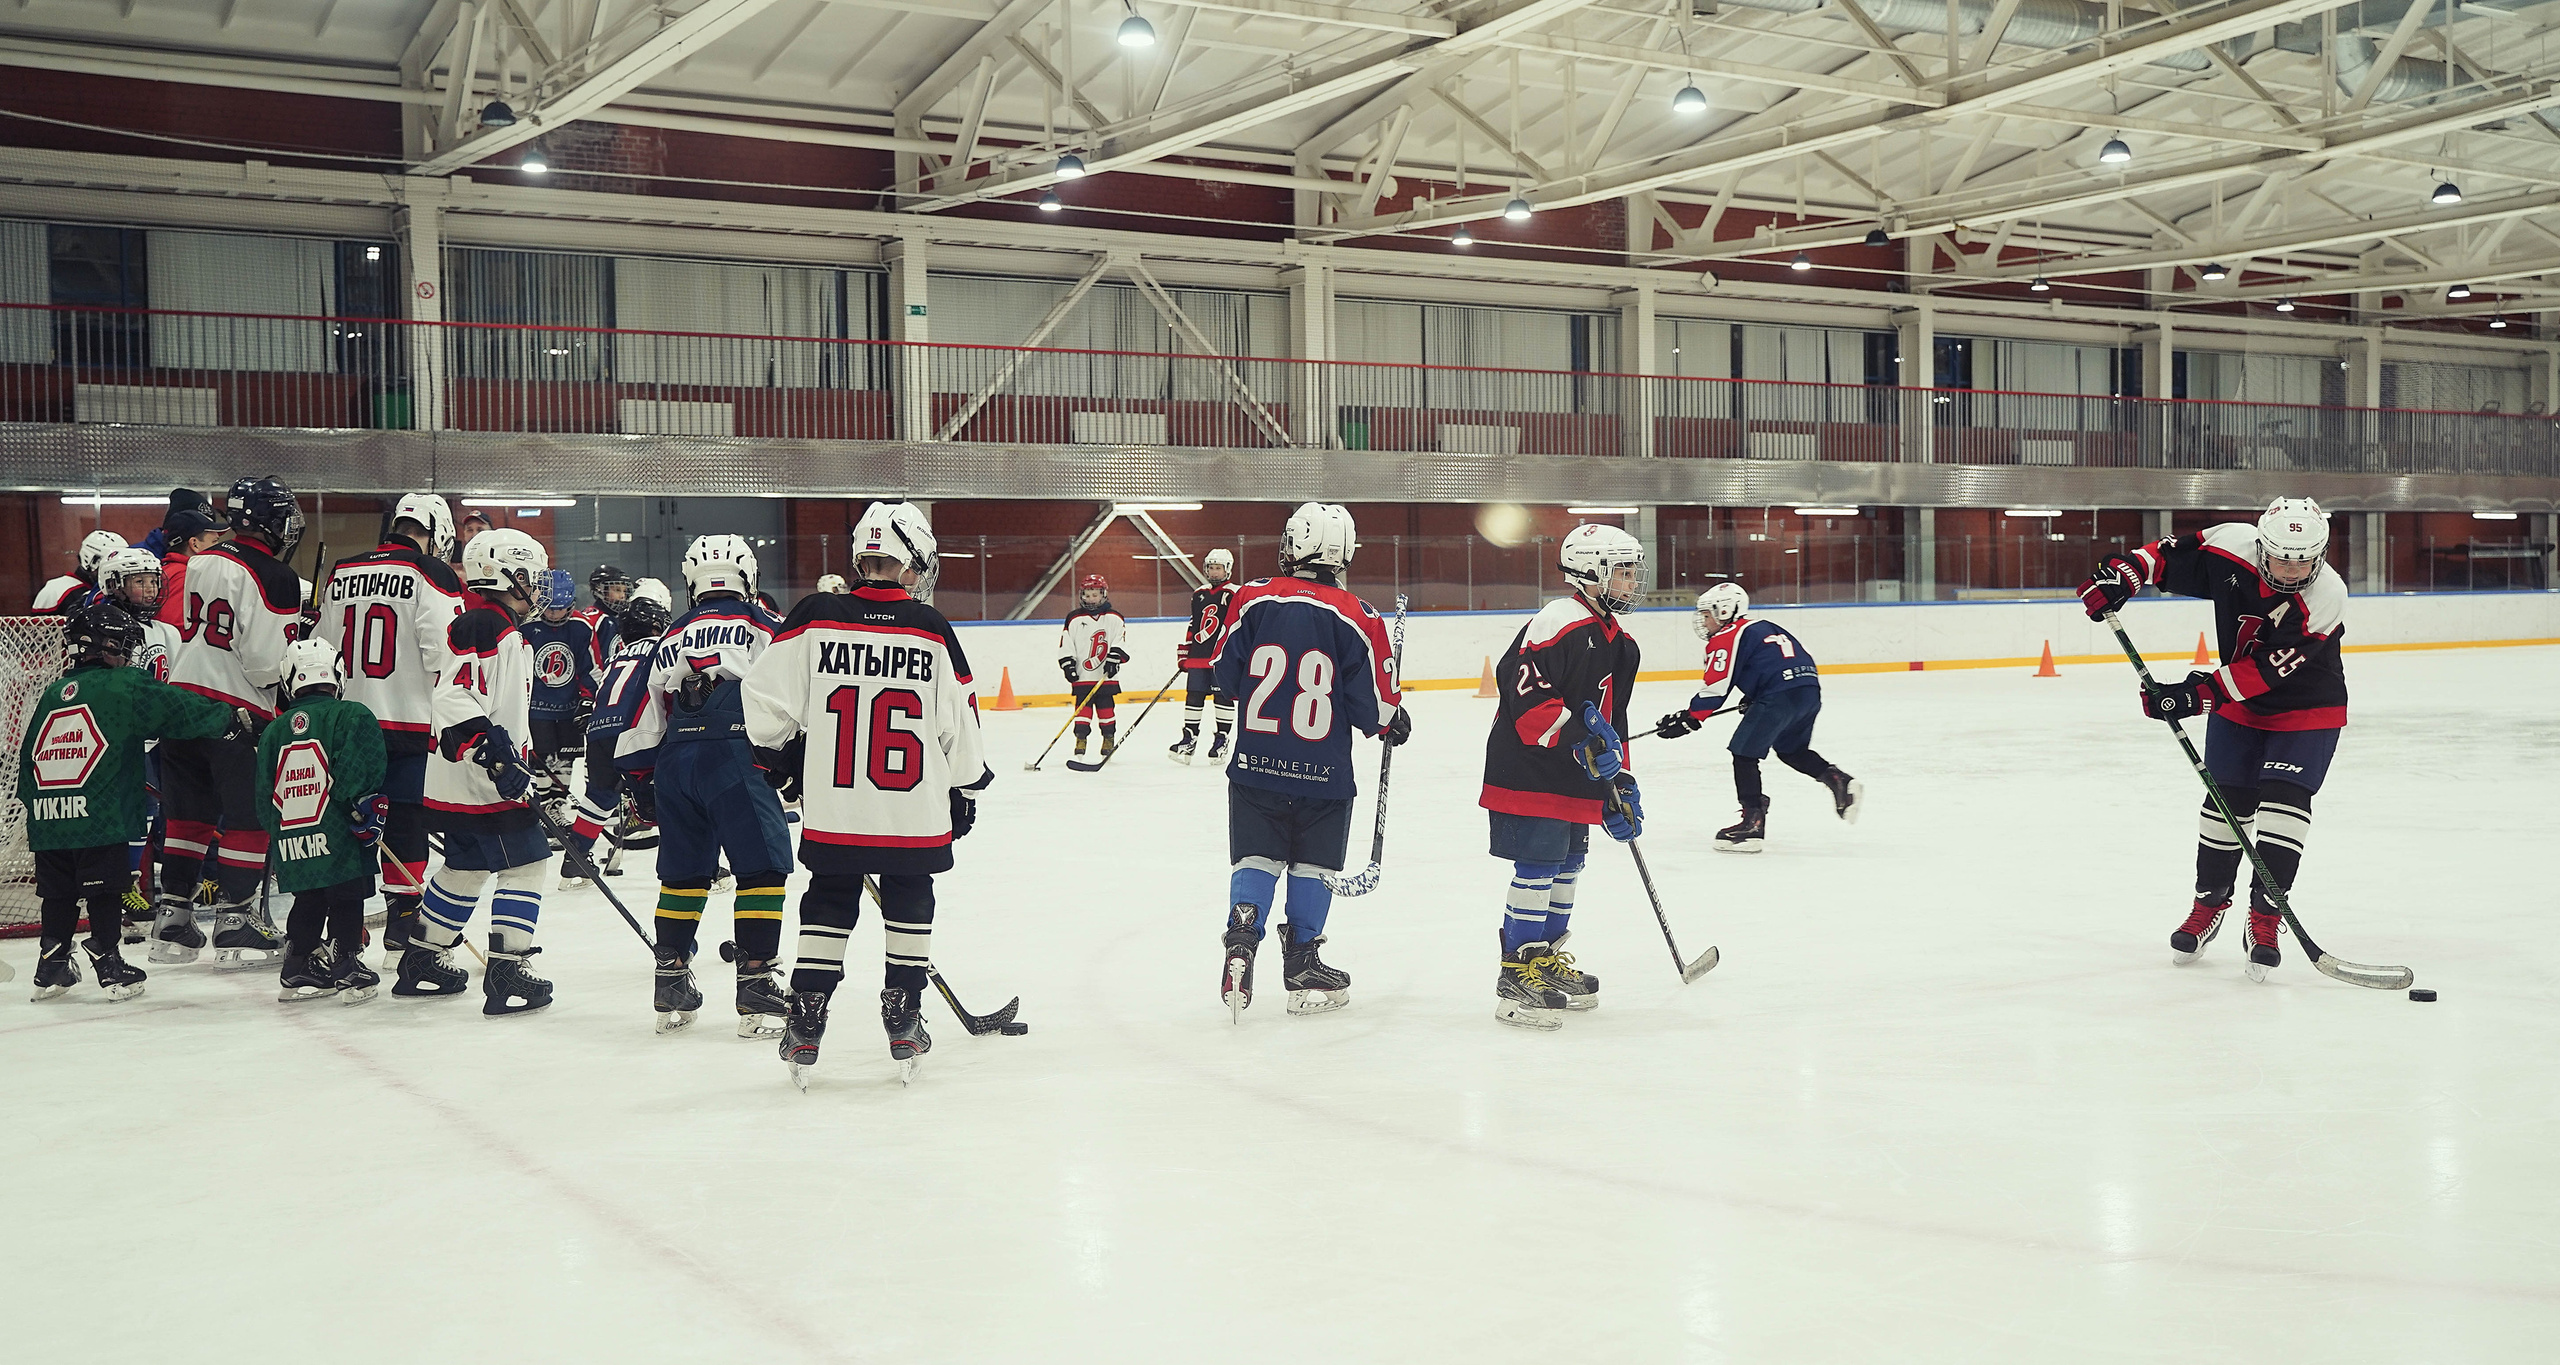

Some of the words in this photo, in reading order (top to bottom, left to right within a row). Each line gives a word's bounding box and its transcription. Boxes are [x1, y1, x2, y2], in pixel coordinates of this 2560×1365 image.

[870, 527, 882, 539] 16
[2289, 523, 2303, 533] 95
[221, 542, 240, 553] LUTCH
[369, 552, 391, 560] LUTCH
[713, 550, 720, 560] 5
[331, 573, 415, 602] СТЕПАНОВ
[863, 613, 895, 621] LUTCH
[2268, 600, 2291, 629] A
[341, 602, 398, 679] 10
[655, 624, 755, 672] МЕЬНИКО
[817, 641, 934, 683] ХАТЫРЕВ
[2268, 646, 2308, 679] 95
[1244, 643, 1336, 742] 28
[826, 685, 924, 792] 16
[1250, 755, 1331, 775] SPINETIX
[1280, 771, 1302, 780] SIGNAGE
[2263, 761, 2304, 774] CCM
[33, 796, 89, 821] VIKHR
[278, 832, 331, 862] VIKHR
